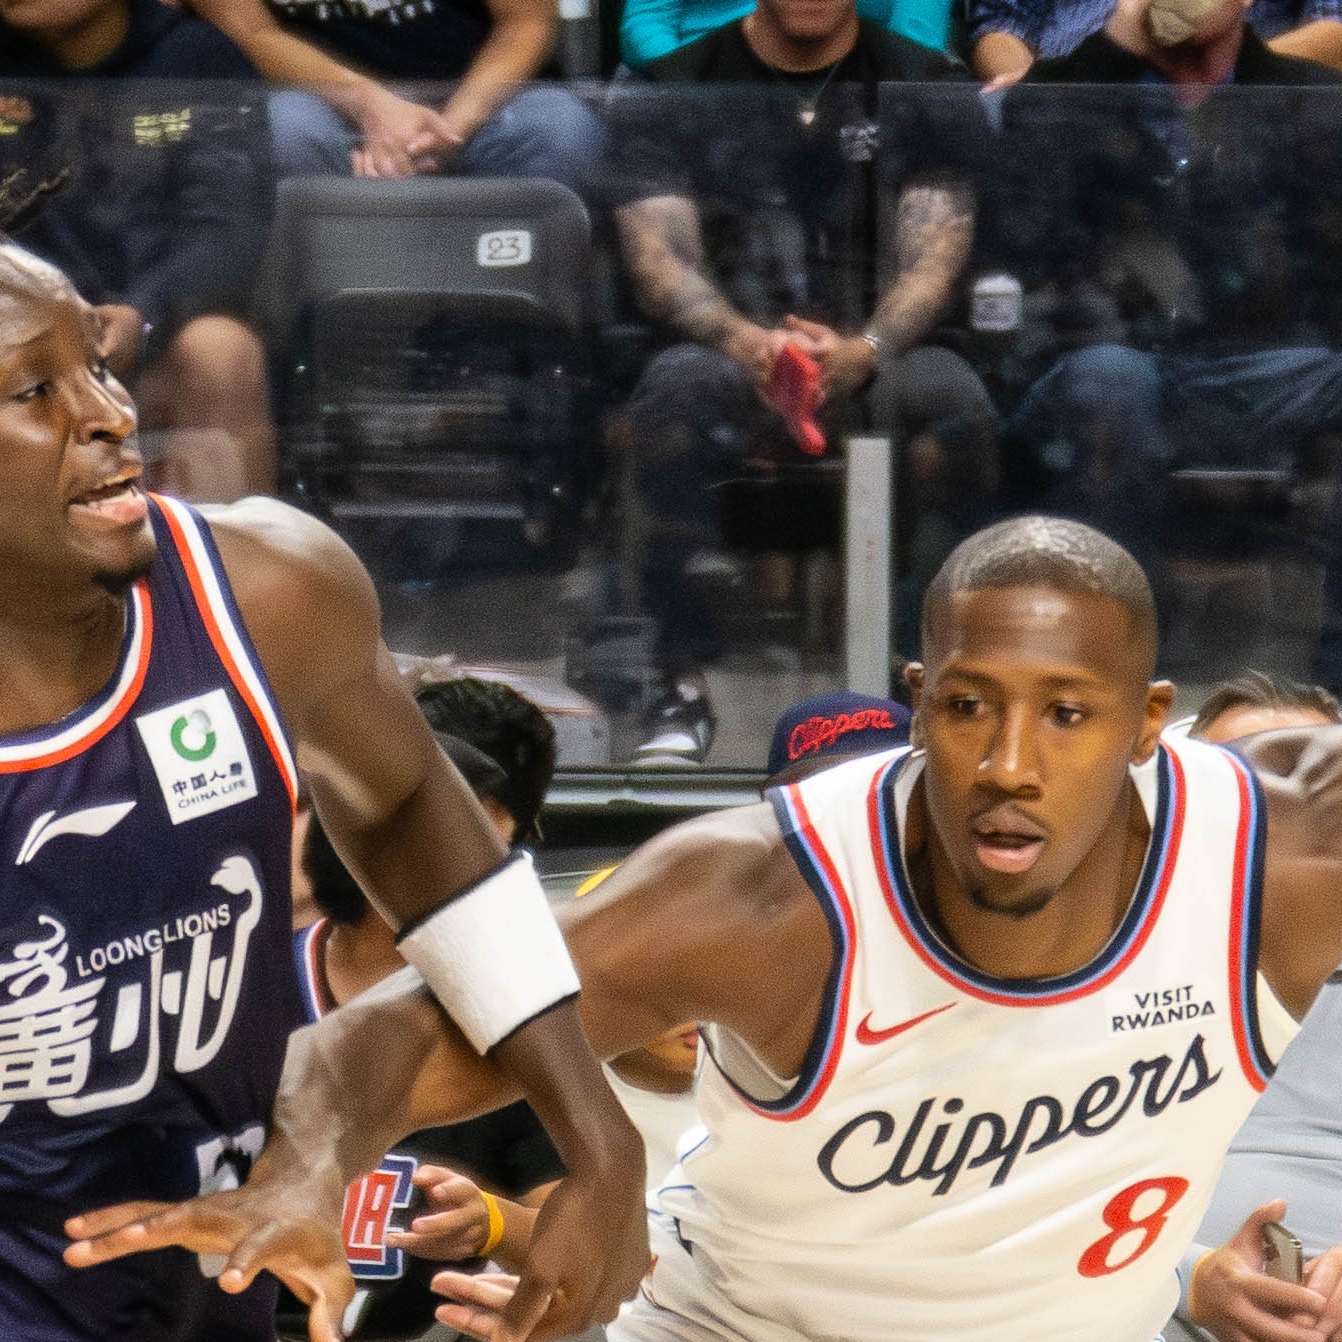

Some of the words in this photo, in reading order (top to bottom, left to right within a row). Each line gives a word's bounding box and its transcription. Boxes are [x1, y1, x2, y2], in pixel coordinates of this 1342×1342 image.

[487, 237, 521, 260] 23
[787, 708, 897, 760] Clippers
[178, 789, 218, 809] CHINA
[221, 778, 247, 796] LIFE
[1134, 984, 1195, 1010] VISIT
[1112, 998, 1216, 1033] RWANDA
[816, 1032, 1224, 1197] Clippers
[1077, 1175, 1191, 1279] 8
